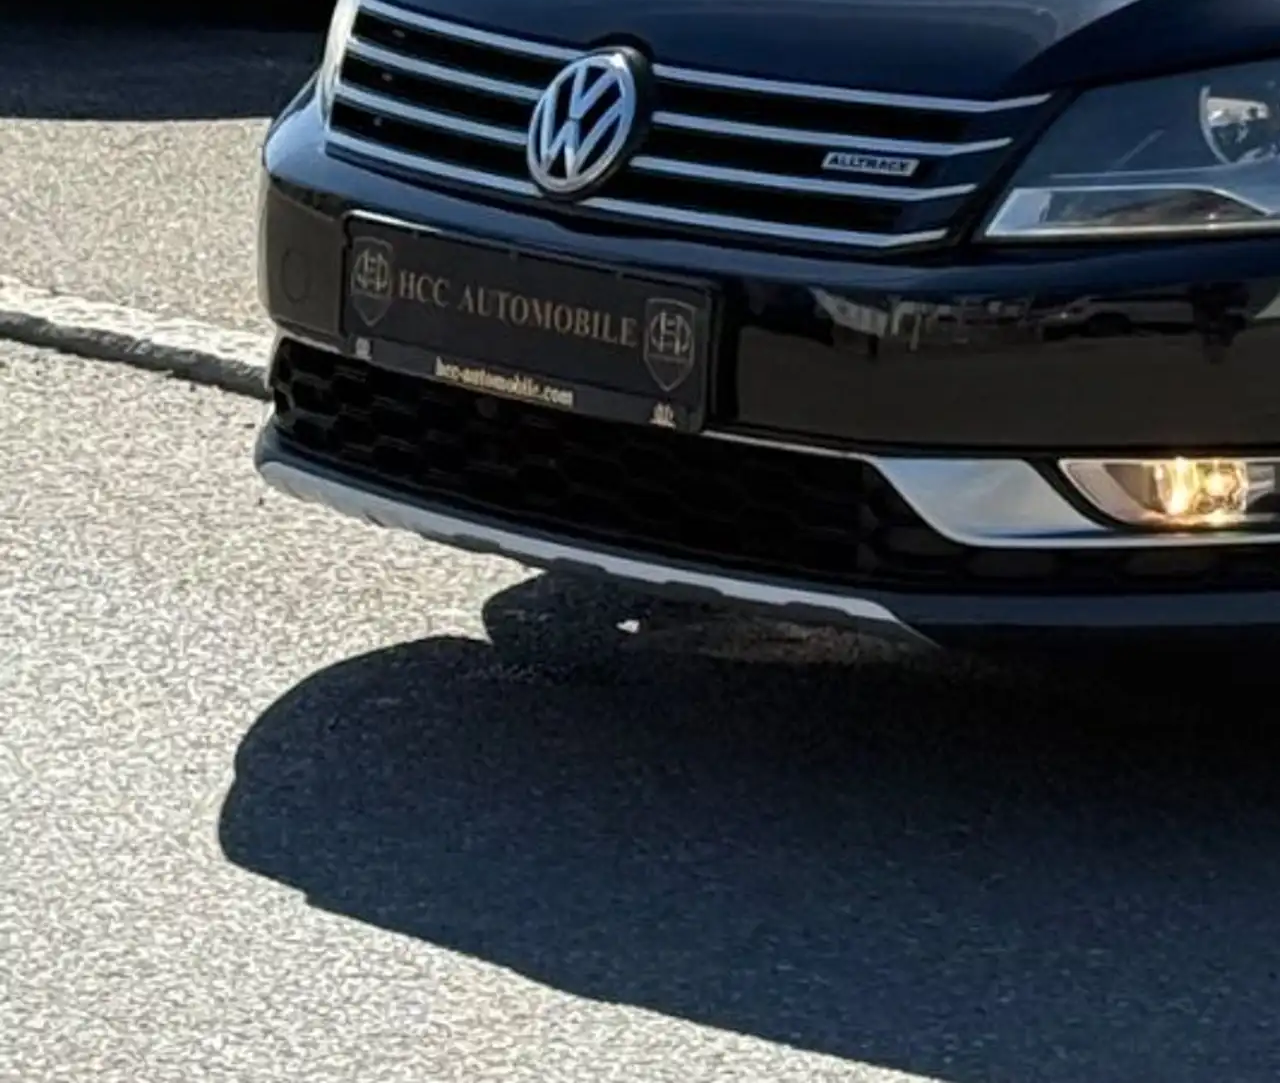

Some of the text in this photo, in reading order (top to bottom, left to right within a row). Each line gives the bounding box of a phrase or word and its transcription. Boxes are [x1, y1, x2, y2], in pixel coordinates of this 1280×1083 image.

[526, 51, 637, 194] VW
[826, 154, 911, 174] ALLTRACK
[399, 268, 451, 309] HCC
[457, 284, 638, 350] AUTOMOBILE
